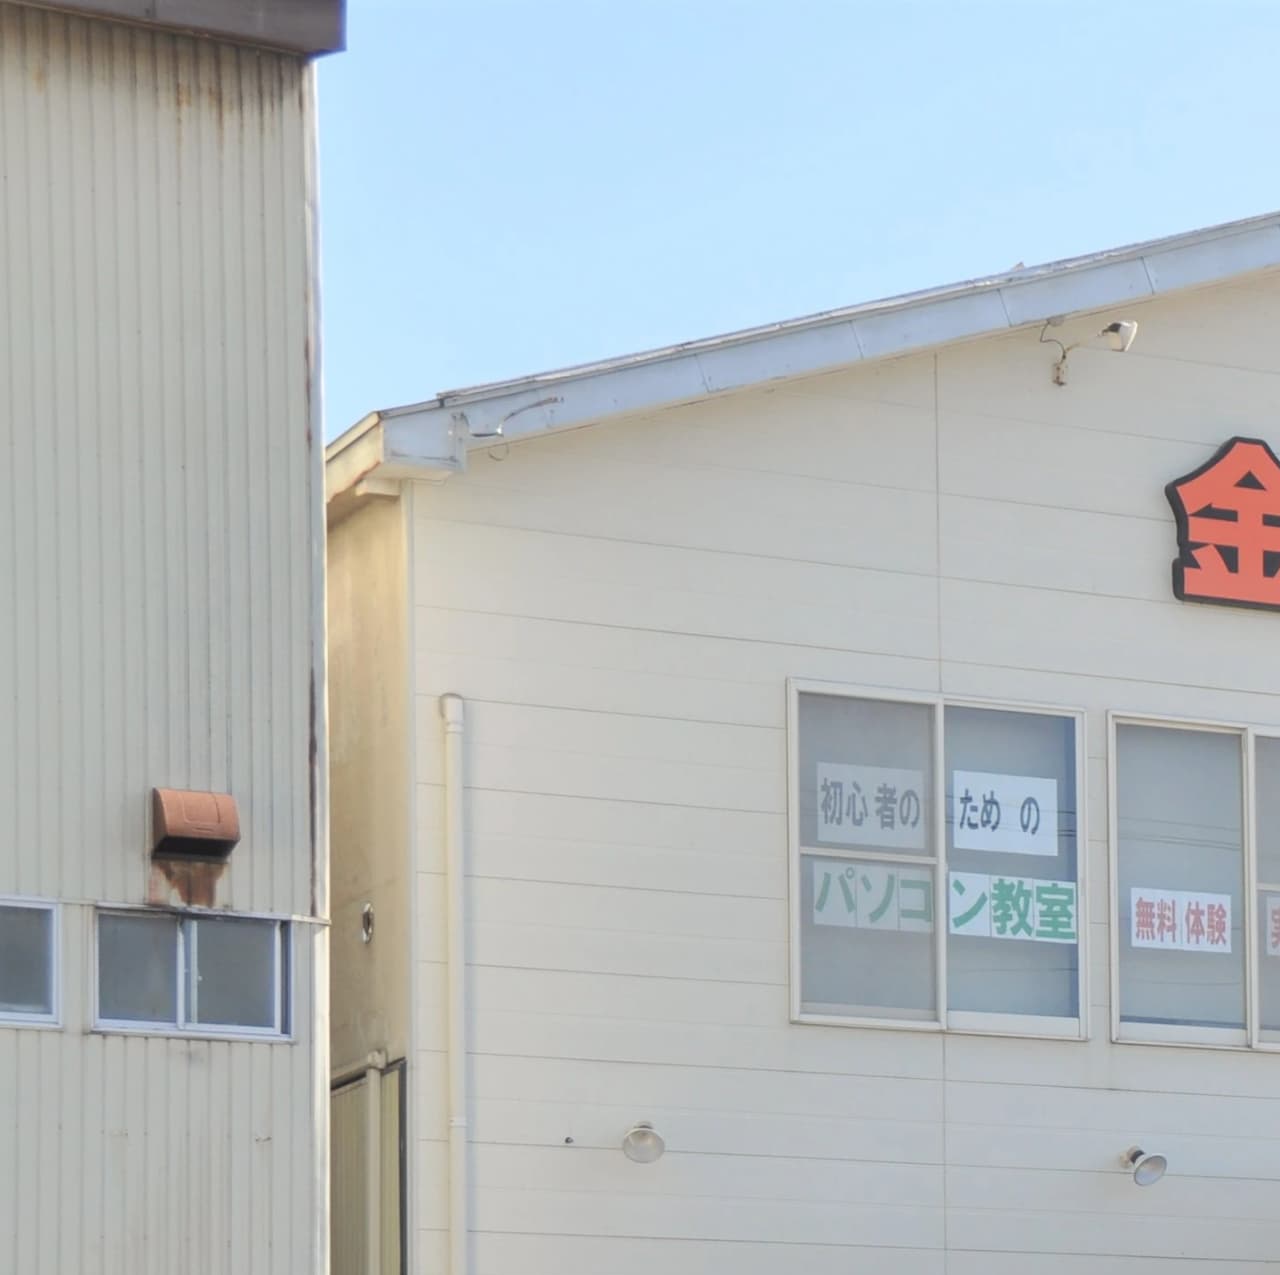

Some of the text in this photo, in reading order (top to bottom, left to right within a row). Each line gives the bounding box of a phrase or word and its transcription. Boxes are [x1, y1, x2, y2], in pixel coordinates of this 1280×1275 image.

[820, 778, 1041, 836] 初心者の ための
[814, 868, 1076, 942] パソコン教室
[1134, 897, 1228, 946] 無料体験
